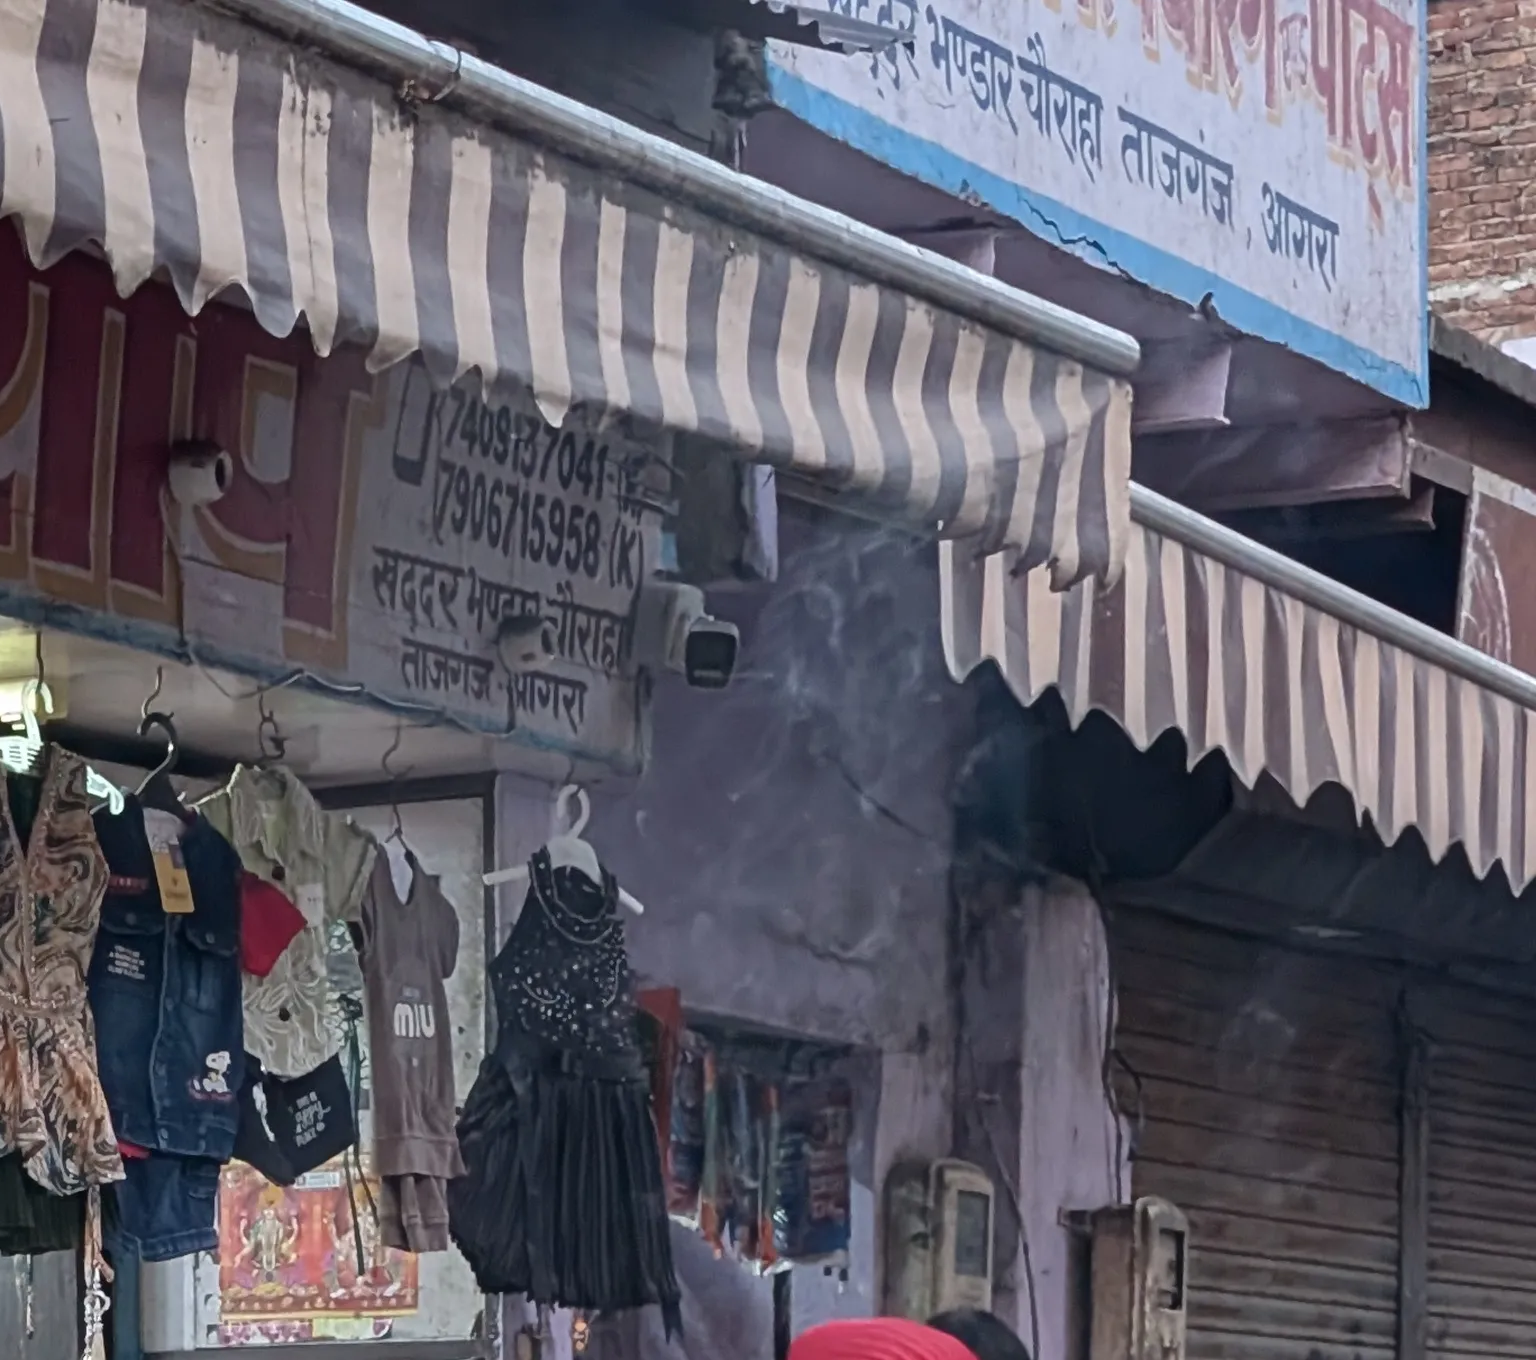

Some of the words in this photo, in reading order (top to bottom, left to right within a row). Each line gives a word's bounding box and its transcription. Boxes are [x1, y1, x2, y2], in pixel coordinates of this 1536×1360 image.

[926, 4, 1018, 136] भण्डार
[1015, 31, 1104, 184] चौराहा
[1261, 182, 1341, 292] आगरा
[401, 636, 495, 702] ताजगंज
